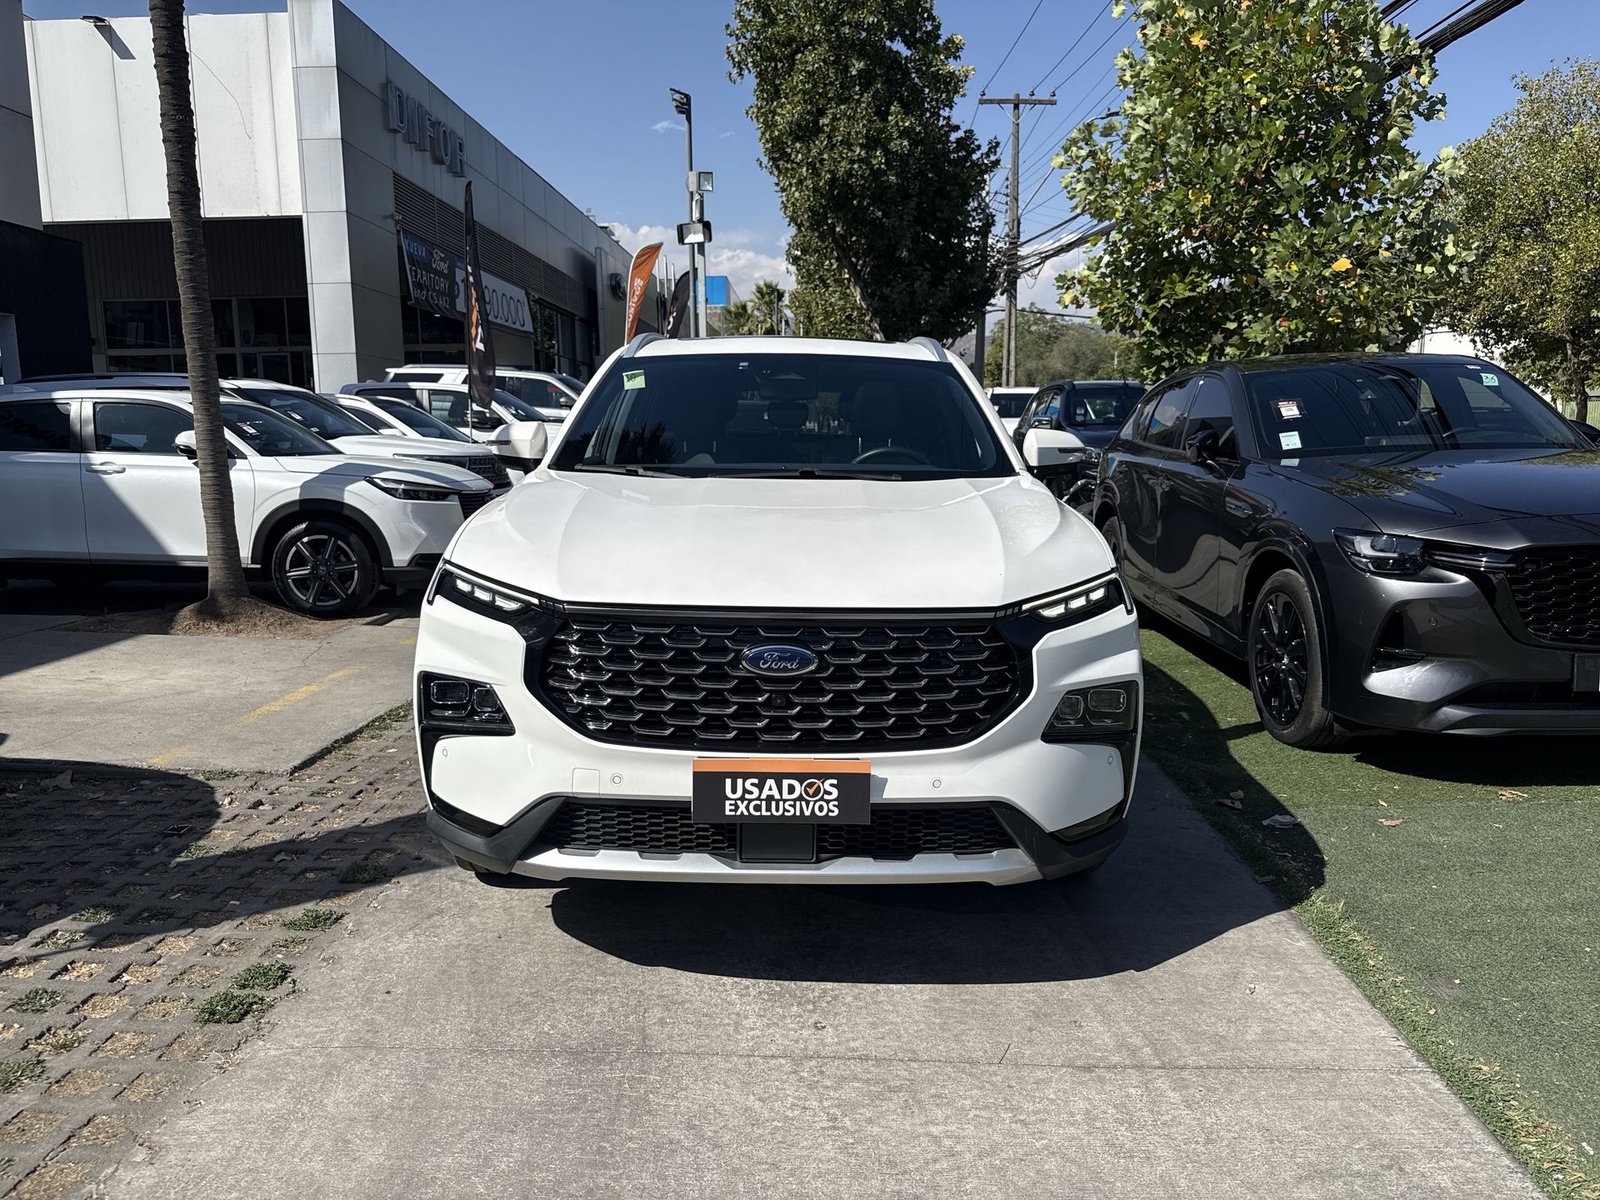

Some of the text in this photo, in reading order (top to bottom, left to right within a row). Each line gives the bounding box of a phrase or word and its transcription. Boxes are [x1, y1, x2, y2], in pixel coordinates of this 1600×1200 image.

[385, 80, 465, 177] DIFOR
[432, 249, 449, 274] Ford
[760, 651, 800, 669] Ford
[725, 778, 839, 800] USADOS
[725, 800, 839, 816] EXCLUSIVOS
